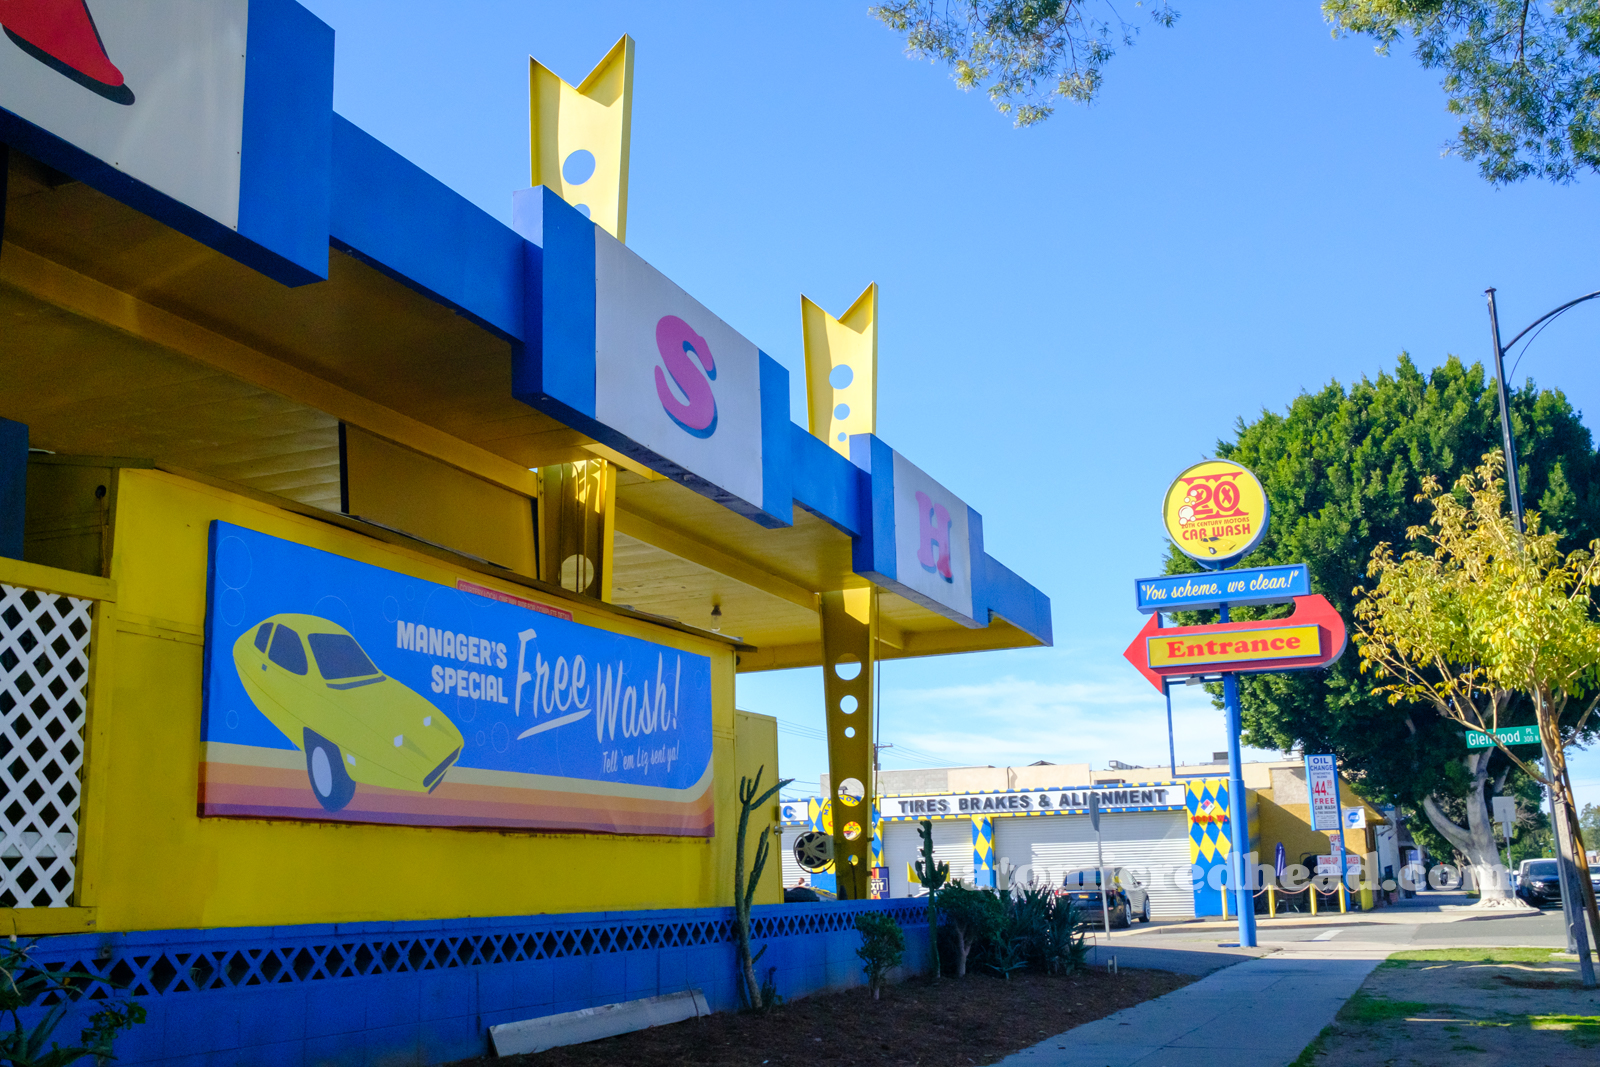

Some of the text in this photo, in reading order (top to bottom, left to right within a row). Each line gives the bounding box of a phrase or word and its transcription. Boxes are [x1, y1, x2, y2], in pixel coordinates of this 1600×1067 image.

[654, 315, 718, 439] S
[1186, 481, 1240, 516] 20
[1182, 524, 1250, 540] CAR WASH
[1197, 519, 1222, 527] CENTURY
[915, 490, 953, 584] H
[1227, 580, 1246, 593] we
[396, 620, 508, 670] MANAGER'S
[1166, 636, 1301, 658] Entrance
[431, 665, 508, 704] SPECIAL
[515, 628, 681, 744] Free Wash!
[1468, 730, 1520, 746] Glenood
[603, 750, 618, 773] Tell
[637, 746, 649, 775] Liz
[898, 799, 948, 814] TIRES
[958, 794, 1030, 810] BRAKES
[1038, 794, 1050, 807] &
[871, 882, 884, 890] XIT
